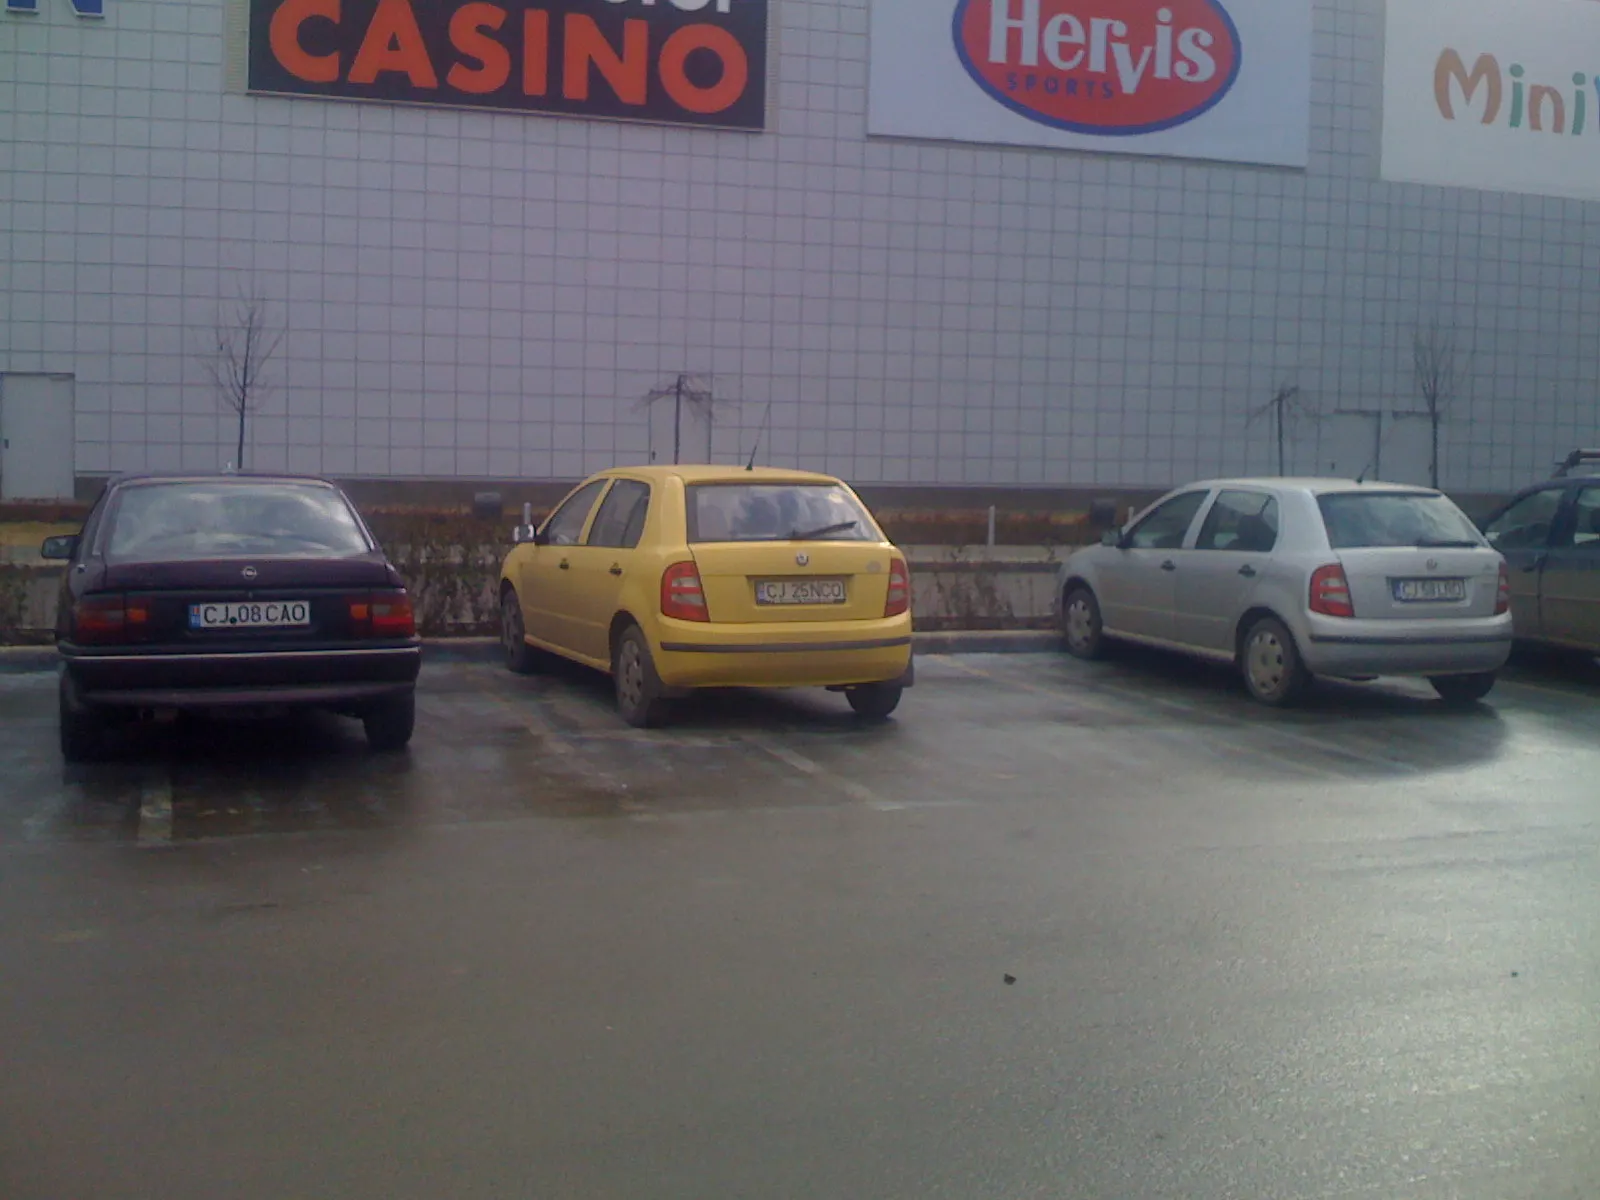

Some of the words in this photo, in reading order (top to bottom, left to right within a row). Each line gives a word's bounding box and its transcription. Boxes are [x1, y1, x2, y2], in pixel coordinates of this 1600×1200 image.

[269, 0, 747, 113] CASINO
[988, 0, 1216, 94] Hervis
[1006, 72, 1114, 99] SPORTS
[1433, 47, 1600, 136] Mini
